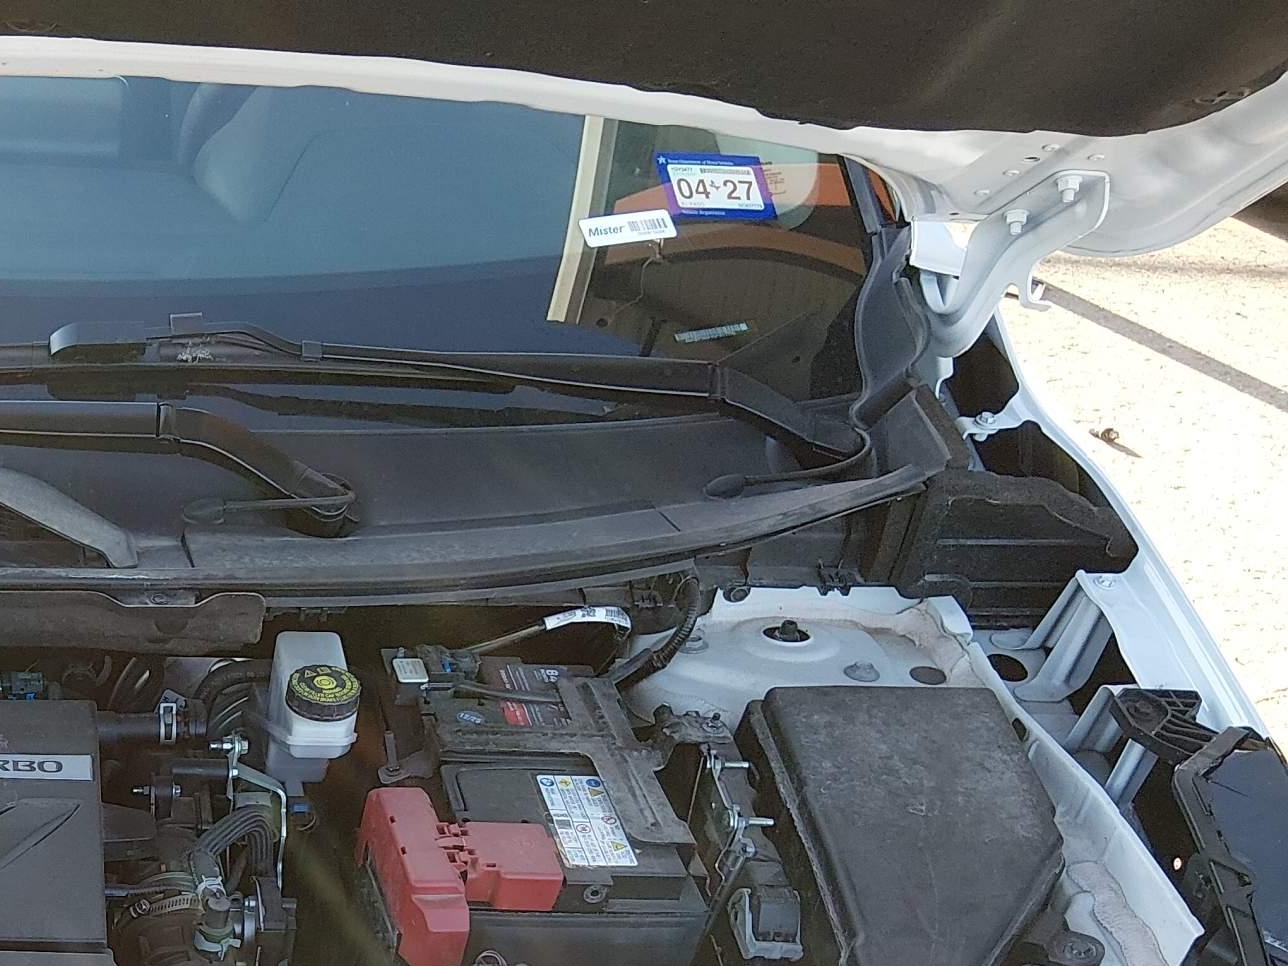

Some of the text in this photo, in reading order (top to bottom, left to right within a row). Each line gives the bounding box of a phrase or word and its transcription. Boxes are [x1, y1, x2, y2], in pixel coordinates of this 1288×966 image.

[676, 177, 711, 200] 04
[723, 178, 753, 201] 27
[588, 225, 624, 238] Mister
